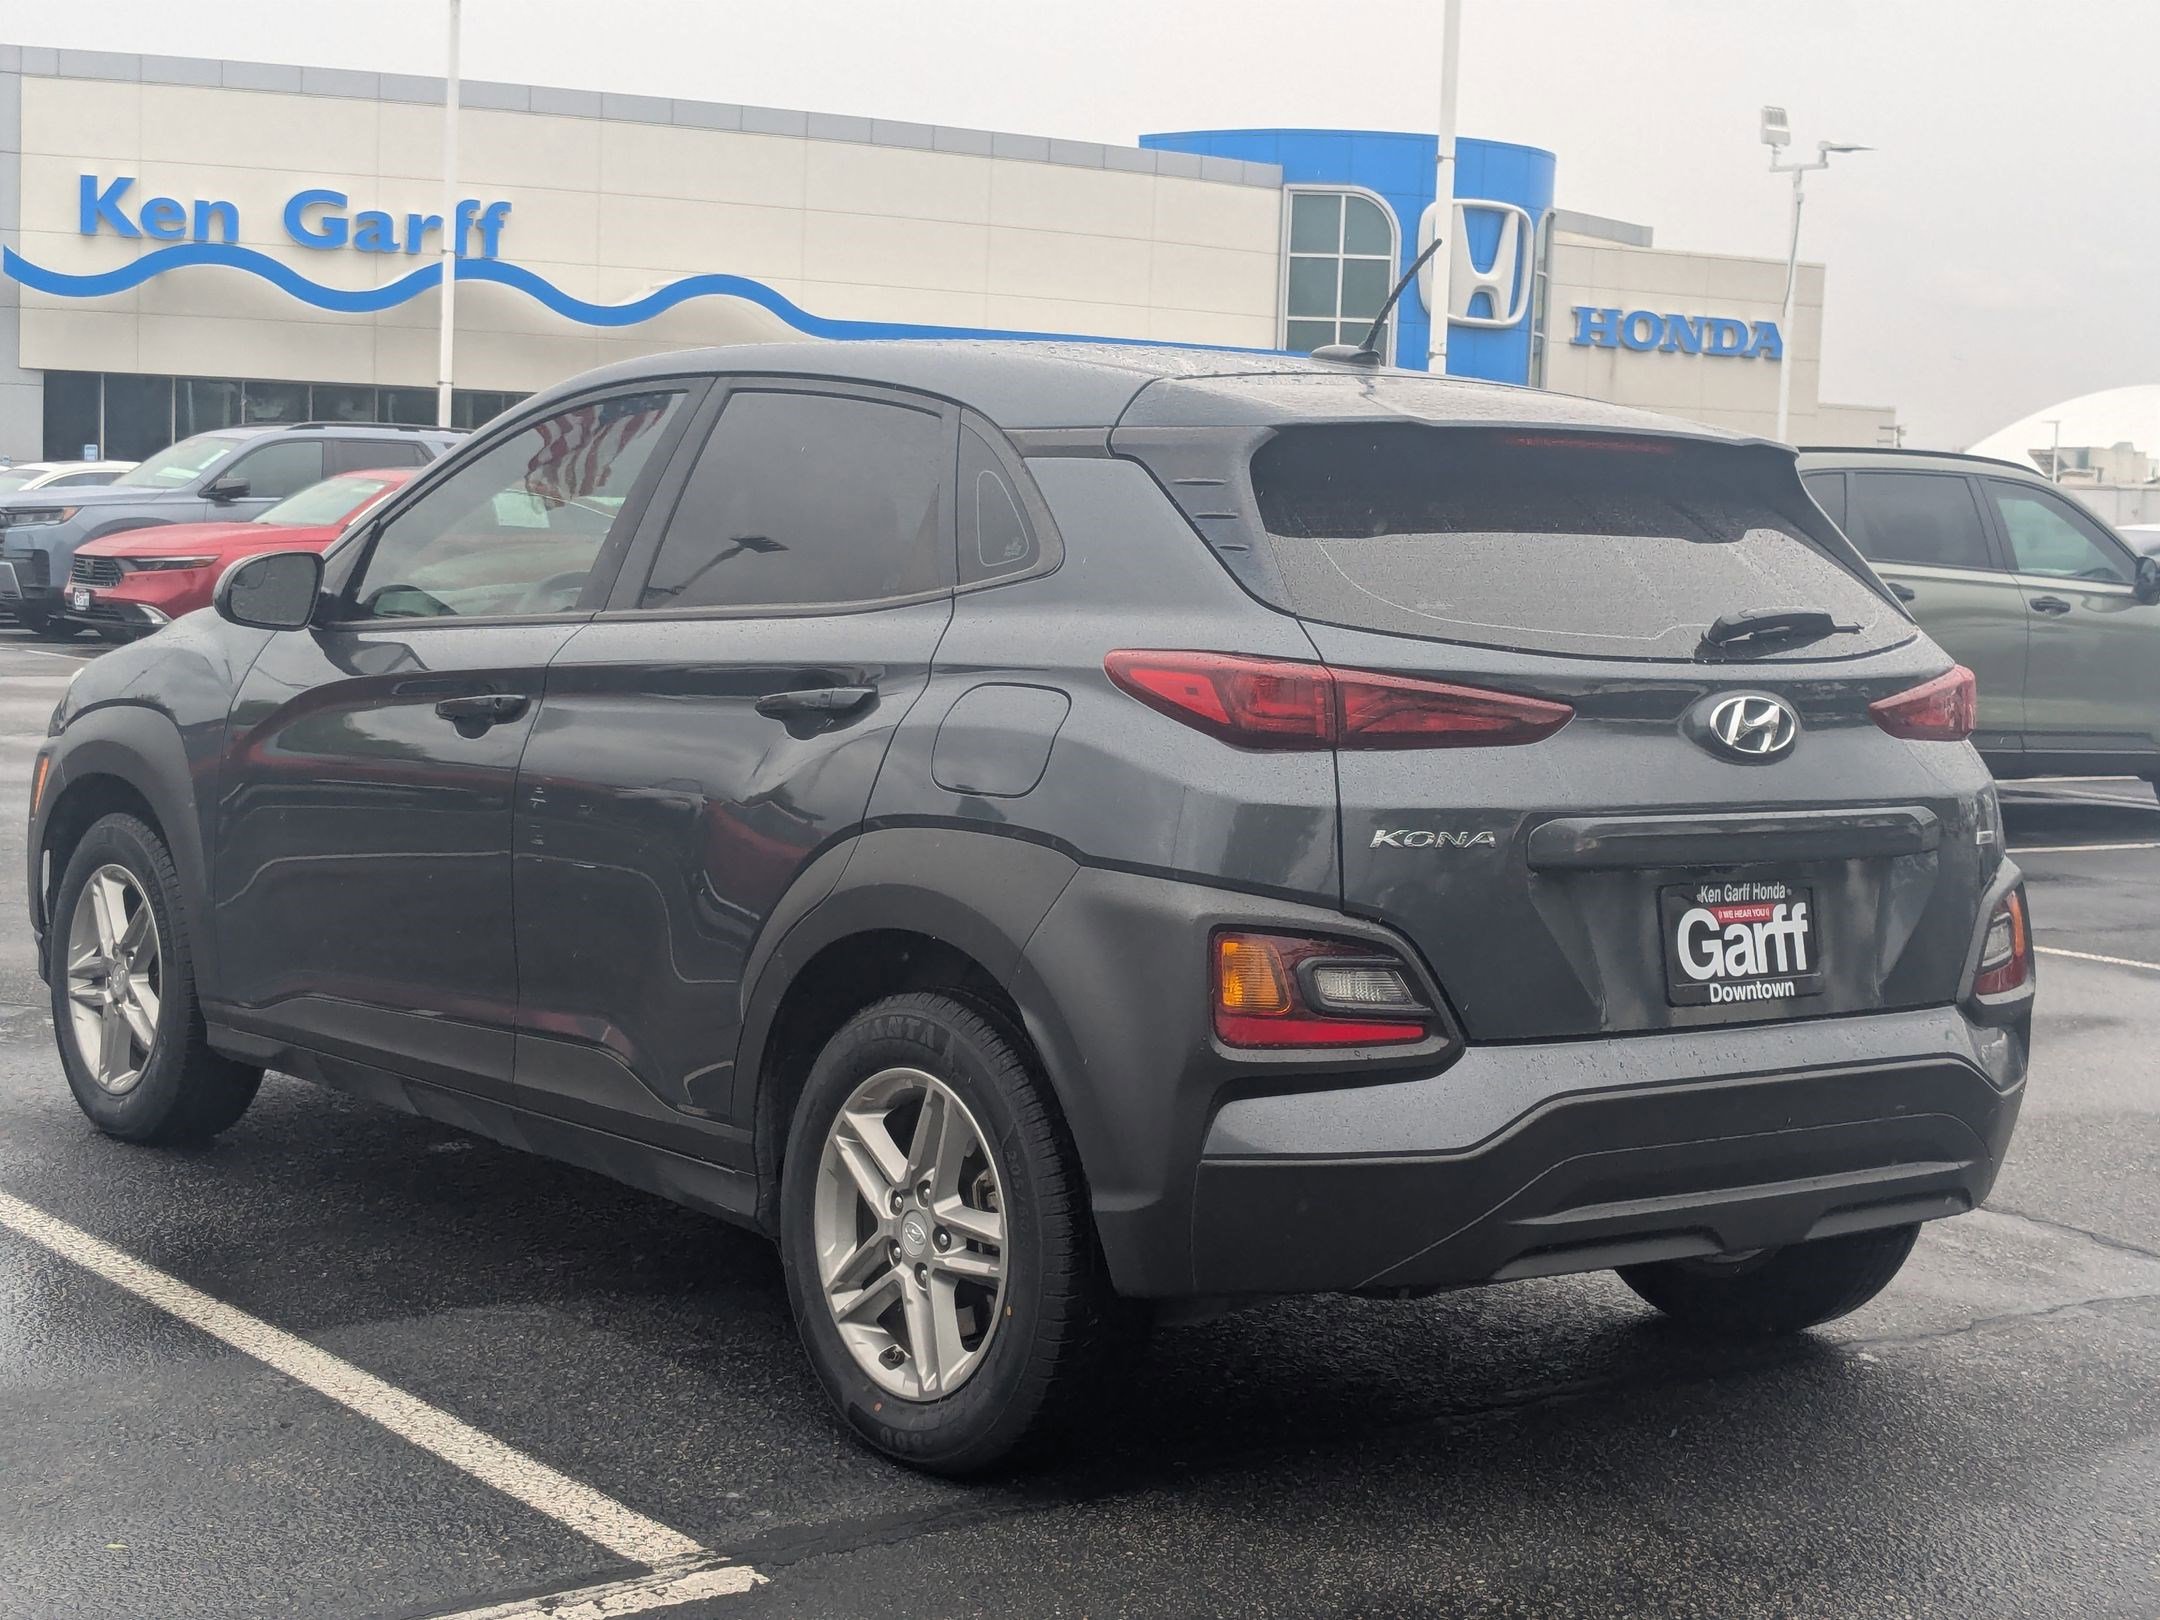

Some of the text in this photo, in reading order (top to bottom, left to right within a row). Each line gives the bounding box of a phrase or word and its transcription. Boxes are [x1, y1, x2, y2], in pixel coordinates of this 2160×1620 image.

[79, 173, 512, 258] Ken Garff
[1570, 305, 1783, 360] HONDA
[1369, 829, 1497, 848] KONA
[1700, 881, 1786, 903] Ken Garff Honda
[1722, 908, 1766, 919] WE HEAR YOU
[1677, 902, 1809, 980] Garff
[1709, 981, 1796, 1003] Downtown
